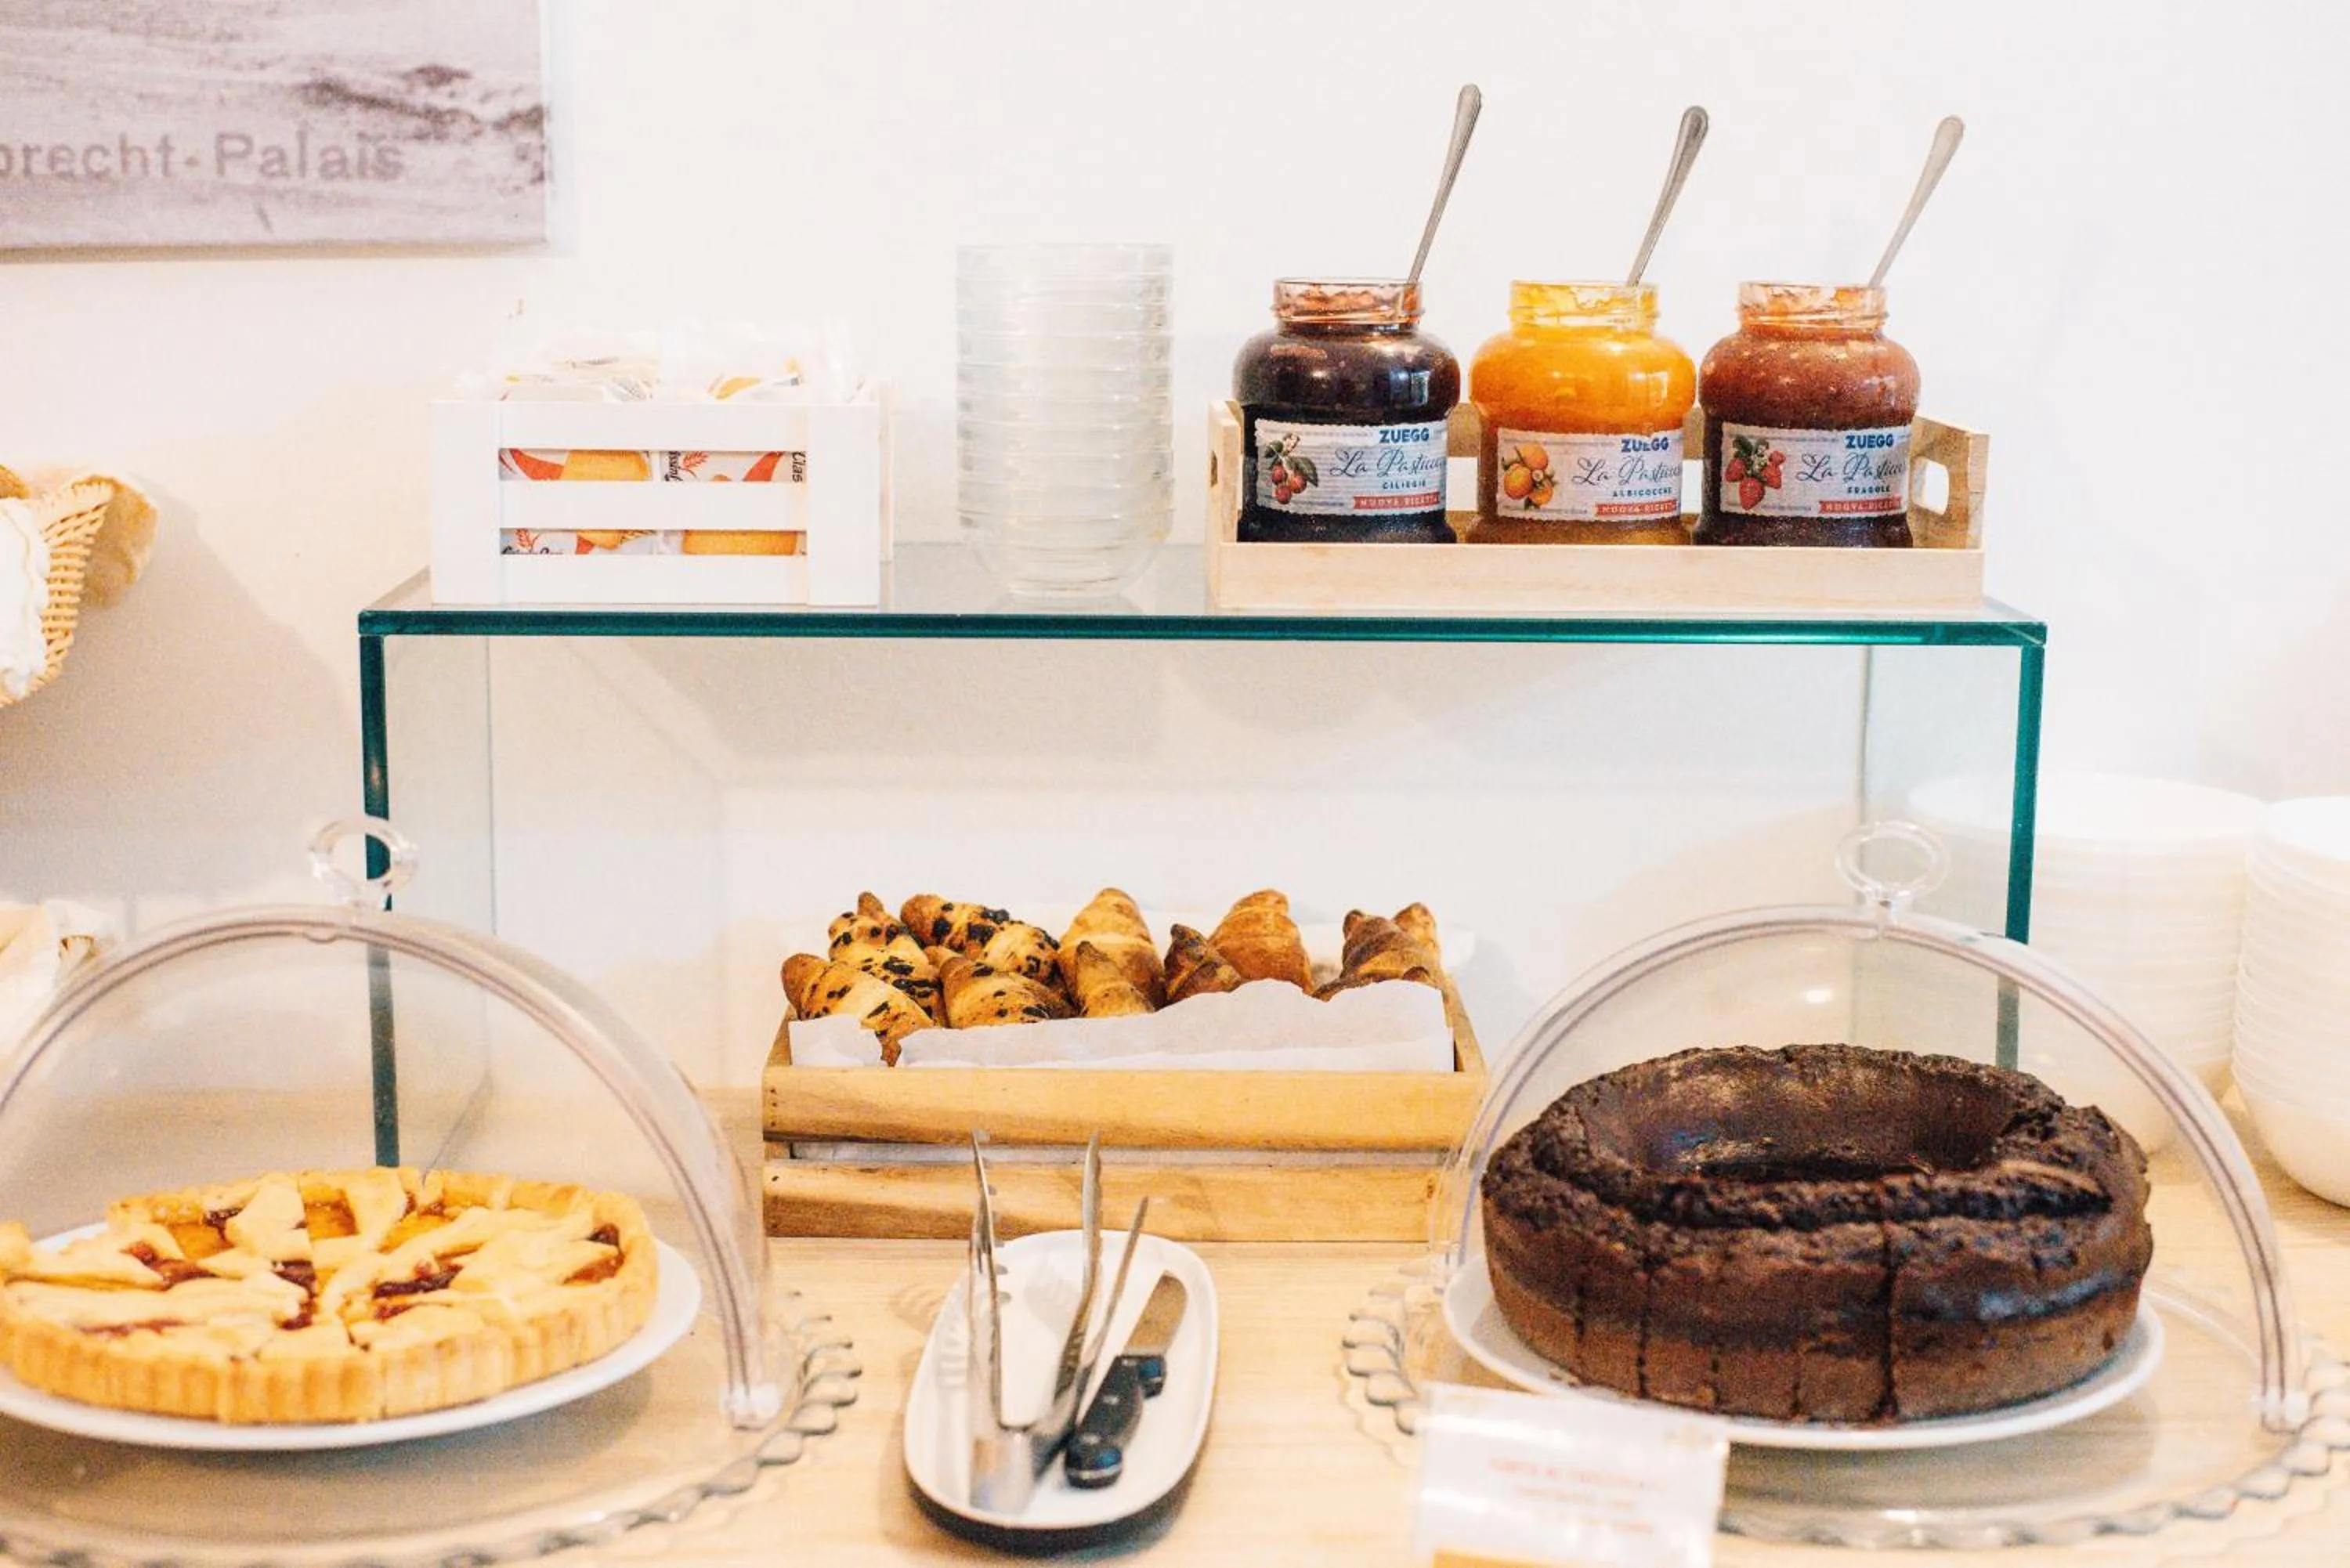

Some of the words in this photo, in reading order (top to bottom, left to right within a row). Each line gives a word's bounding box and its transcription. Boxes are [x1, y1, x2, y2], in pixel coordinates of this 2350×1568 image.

[1379, 428, 1430, 443] ZUEGG
[1846, 434, 1894, 449] ZUEGG
[1622, 437, 1669, 453] ZUEGG
[1330, 447, 1367, 478] La
[1795, 452, 1835, 482] La
[1571, 456, 1610, 486] La
[1612, 486, 1672, 497] ALBICOCCHE
[1847, 485, 1891, 494] FRAGOLE
